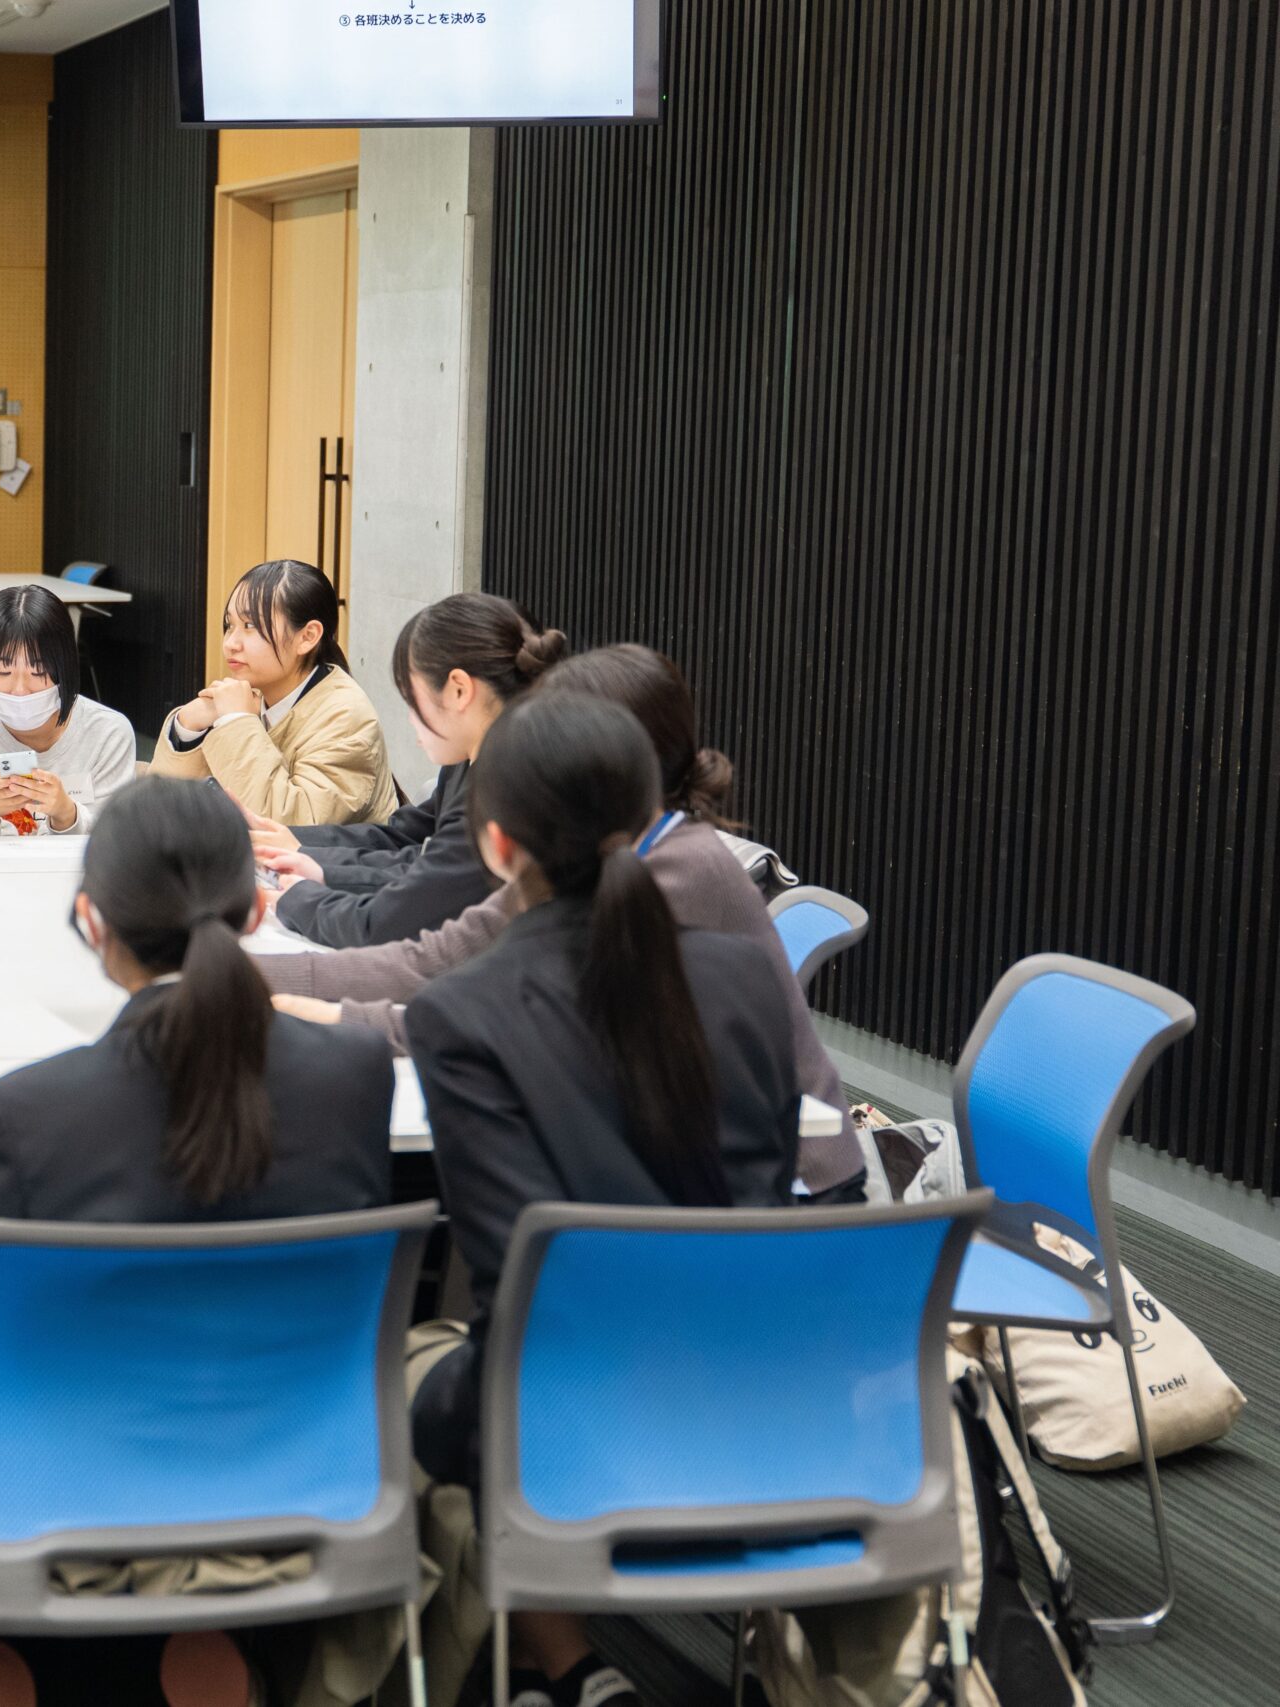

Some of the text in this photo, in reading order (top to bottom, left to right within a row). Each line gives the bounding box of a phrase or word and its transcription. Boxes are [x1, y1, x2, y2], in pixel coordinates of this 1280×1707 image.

[339, 12, 487, 27] ③ 各班決めることを決める
[1147, 1374, 1188, 1397] Fueki
